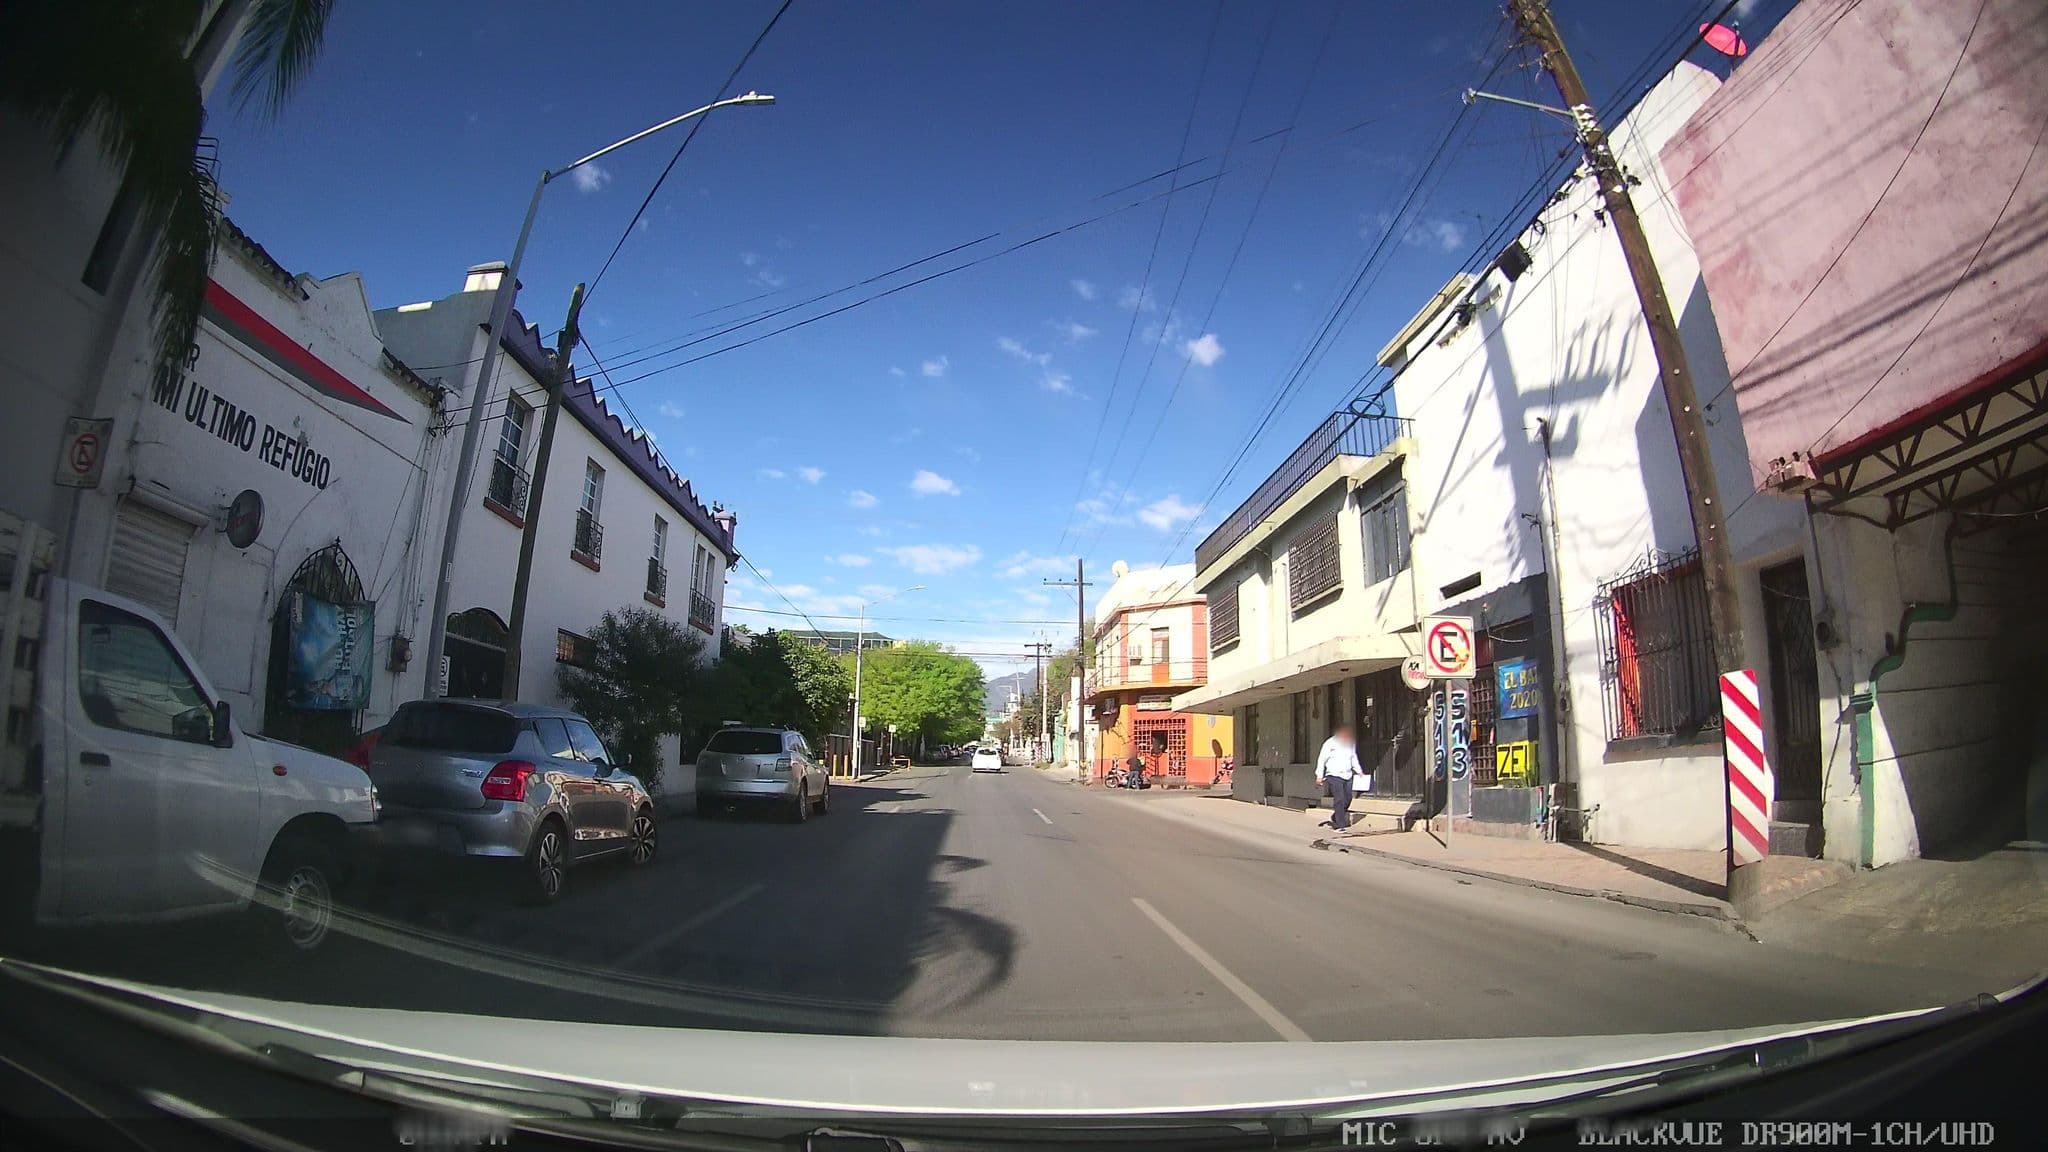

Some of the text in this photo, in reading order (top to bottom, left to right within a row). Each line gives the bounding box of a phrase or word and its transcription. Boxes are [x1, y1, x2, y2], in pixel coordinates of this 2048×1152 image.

[185, 382, 256, 452] ULTIMO
[258, 424, 331, 490] REFUGIO
[1504, 672, 1517, 690] EL
[1510, 690, 1538, 710] 2020
[1452, 690, 1468, 781] 513
